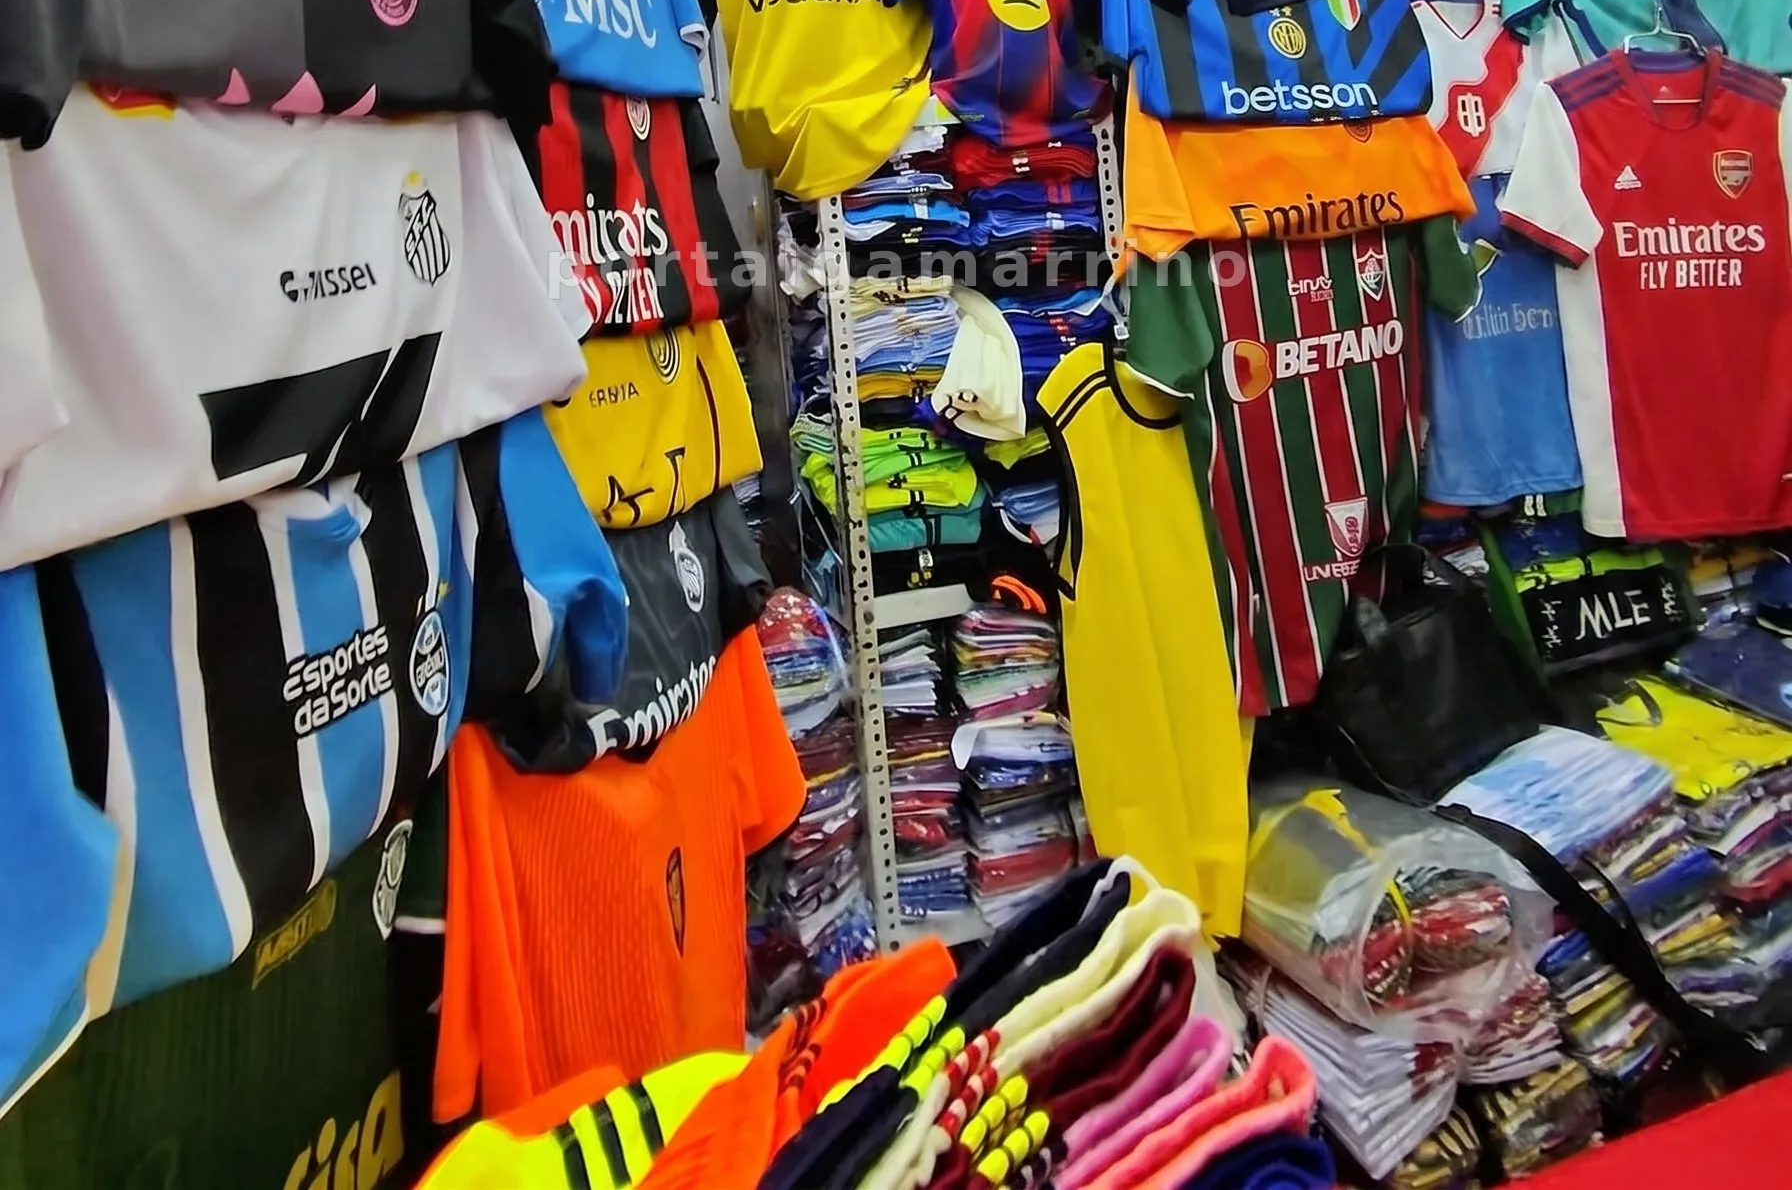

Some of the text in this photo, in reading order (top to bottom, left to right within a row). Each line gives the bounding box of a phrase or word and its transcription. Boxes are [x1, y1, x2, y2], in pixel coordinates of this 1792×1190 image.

[1221, 79, 1379, 115] betsson
[1229, 191, 1405, 240] Emirates
[1612, 217, 1766, 258] Emirates
[1640, 259, 1742, 290] FLY BETTER
[1275, 319, 1404, 379] BETANO
[282, 625, 390, 702] Esportes
